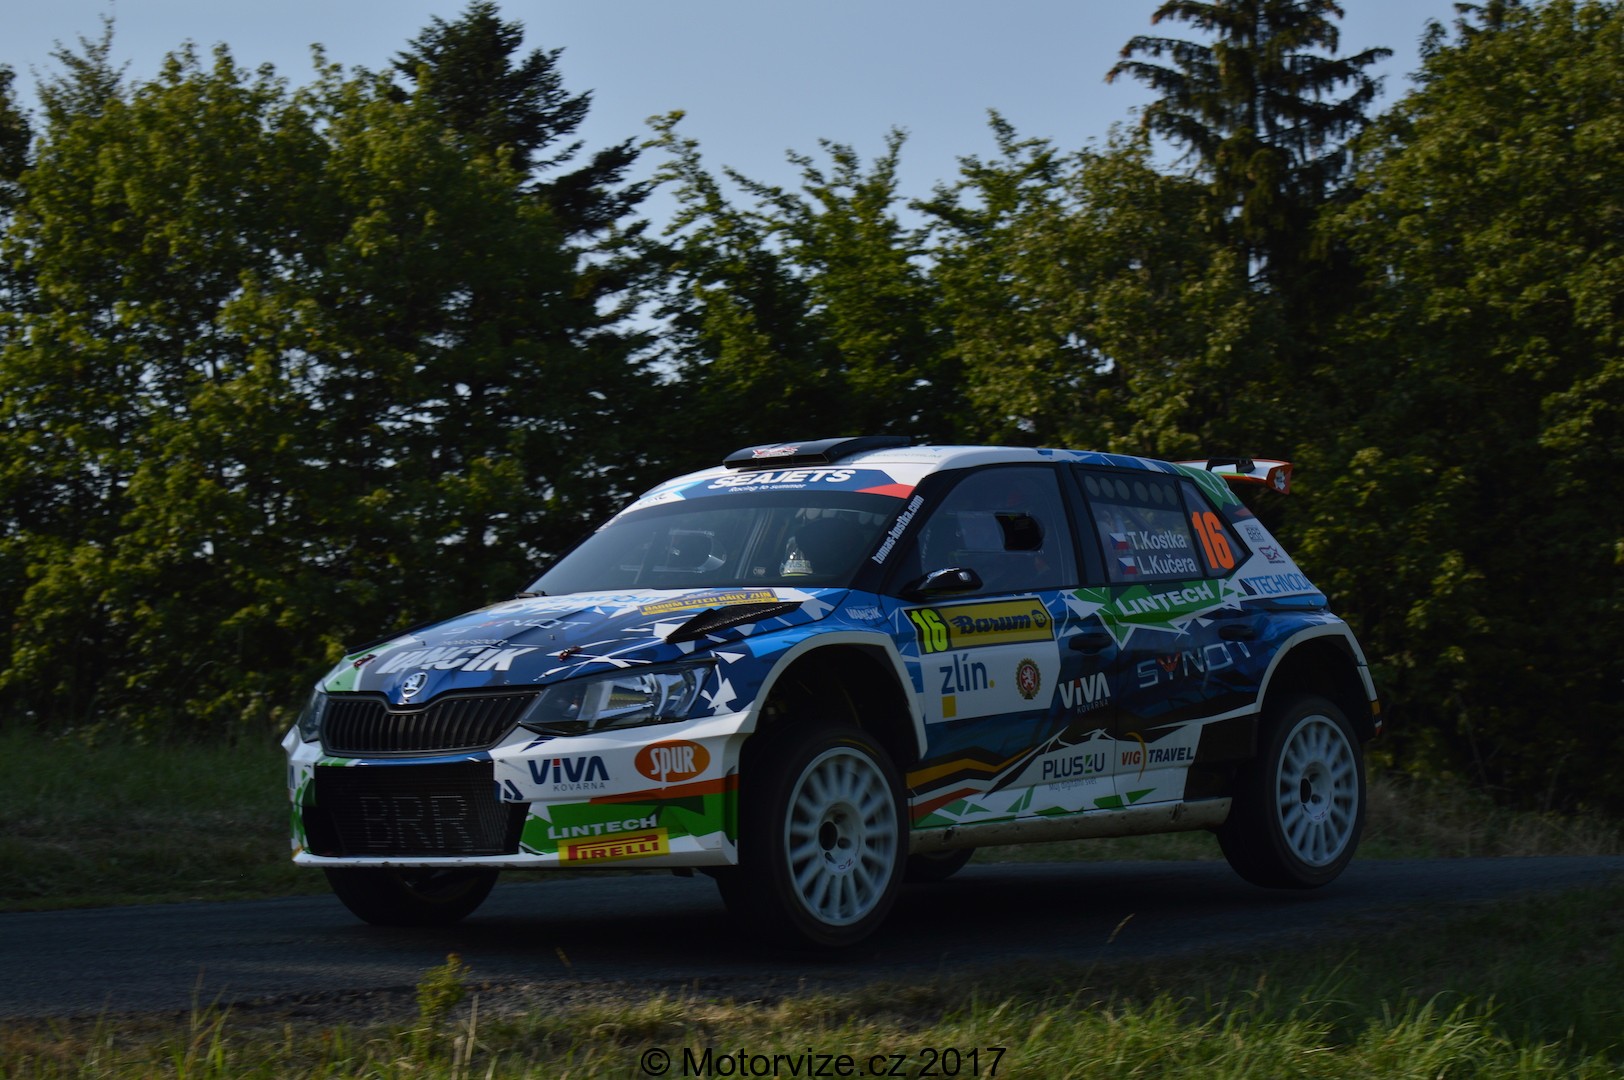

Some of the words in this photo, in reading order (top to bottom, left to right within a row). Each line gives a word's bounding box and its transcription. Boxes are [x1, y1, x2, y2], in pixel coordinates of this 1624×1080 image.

[707, 469, 857, 490] SEAJETS
[871, 494, 925, 565] tomas-kostka.com
[1127, 530, 1188, 551] T.Kostka
[1191, 511, 1236, 570] 16
[1137, 554, 1198, 576] L.Kučera
[1115, 586, 1216, 617] LINTECH
[442, 618, 592, 635] SYNOT
[910, 608, 949, 654] 16
[952, 614, 1031, 635] Barum
[1136, 641, 1251, 689] SYNOT
[650, 745, 697, 790] SPUR
[1043, 752, 1105, 780] PLUS4U
[1121, 751, 1141, 766] VIG
[1149, 747, 1194, 763] TRAVEL
[360, 795, 473, 849] BRR
[547, 814, 657, 840] LINTECH
[568, 835, 660, 860] PIRELLI
